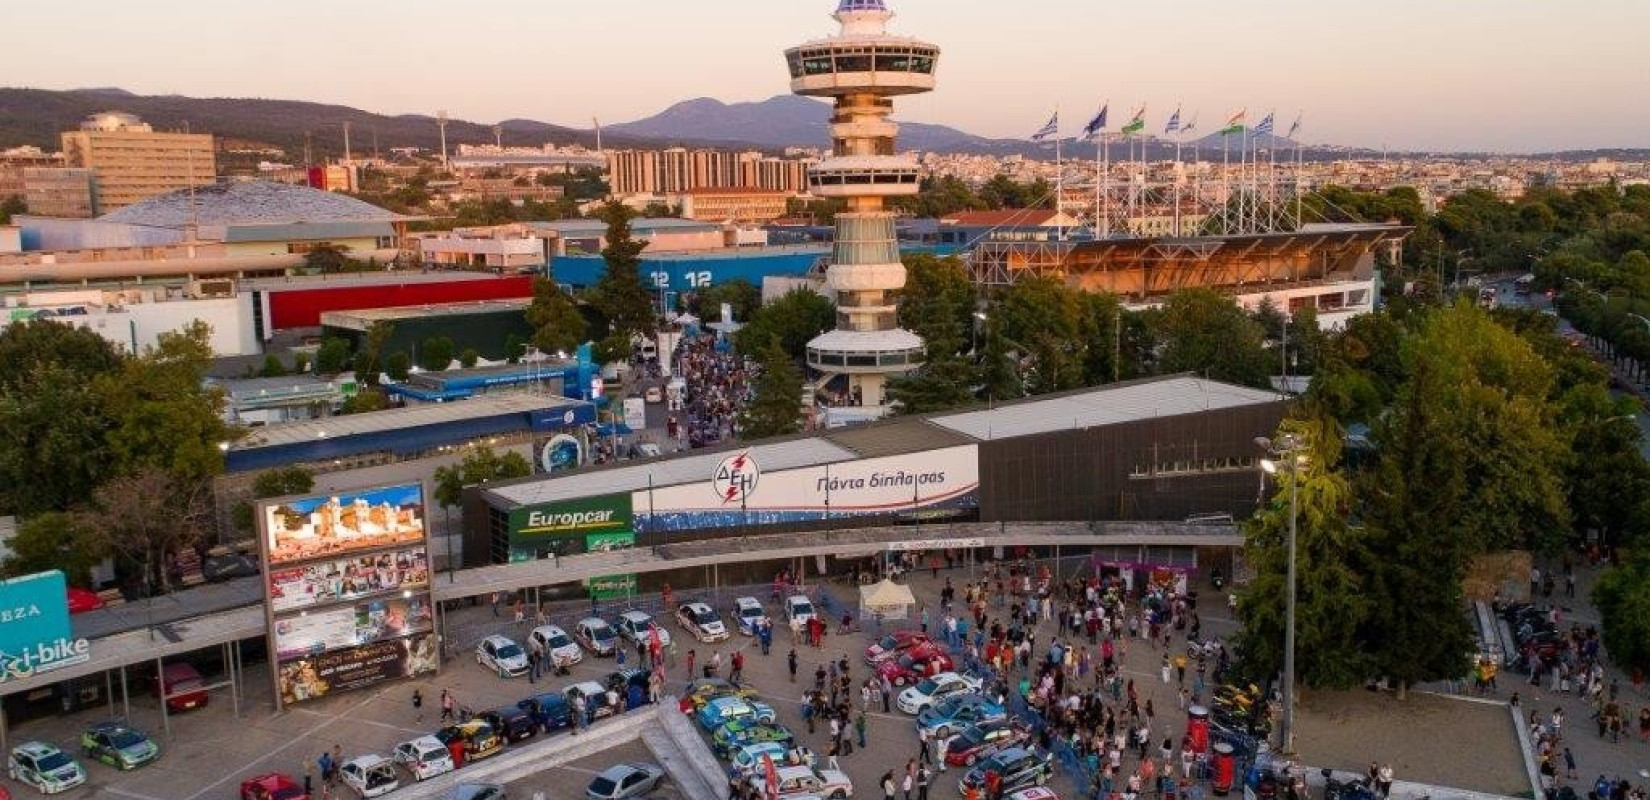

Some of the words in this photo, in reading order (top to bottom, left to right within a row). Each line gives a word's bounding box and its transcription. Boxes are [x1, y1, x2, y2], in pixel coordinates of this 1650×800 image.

[651, 271, 669, 288] 12
[685, 271, 712, 288] 12
[817, 476, 864, 492] Πάντα
[870, 471, 912, 487] δίπλα
[919, 471, 945, 484] σας
[528, 510, 613, 528] Europcar
